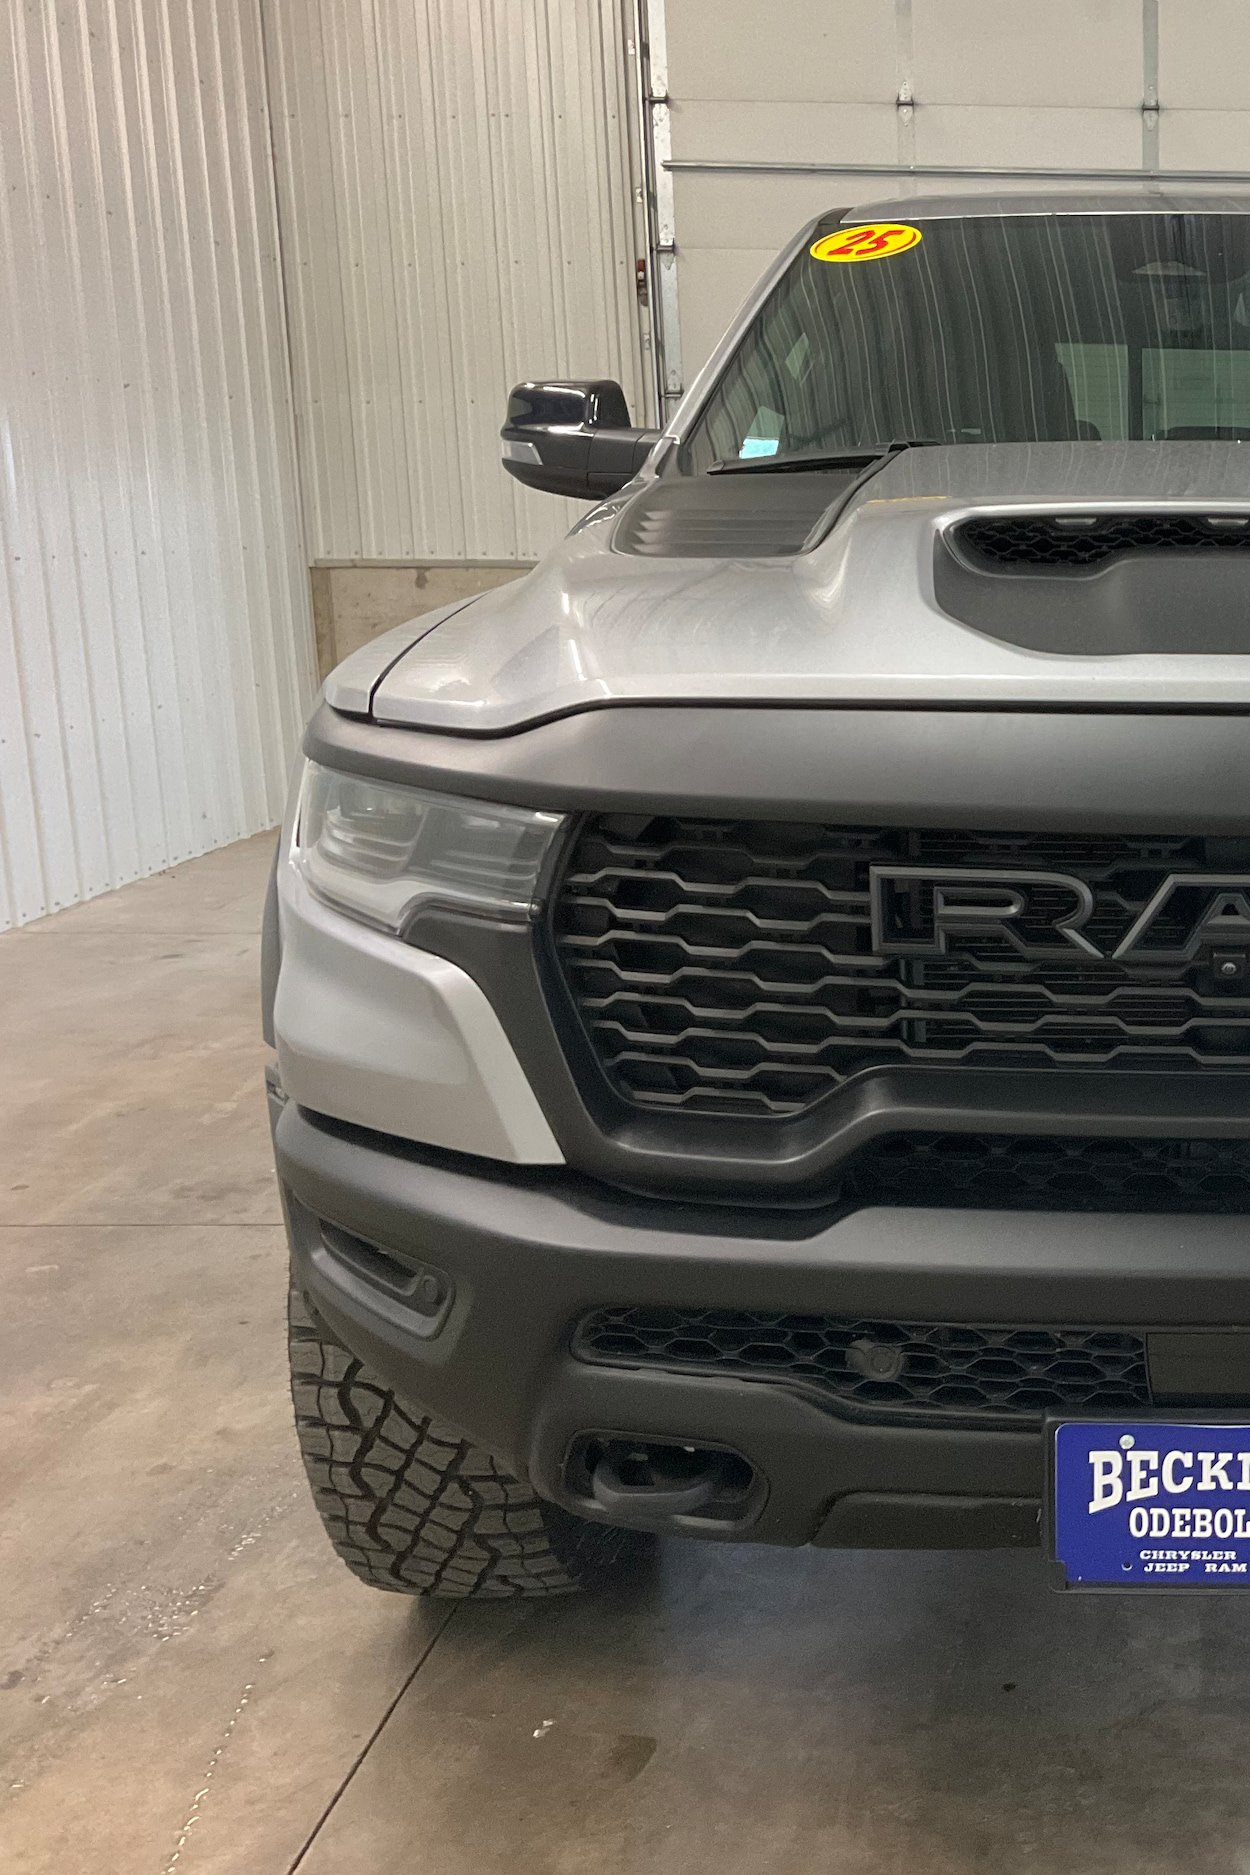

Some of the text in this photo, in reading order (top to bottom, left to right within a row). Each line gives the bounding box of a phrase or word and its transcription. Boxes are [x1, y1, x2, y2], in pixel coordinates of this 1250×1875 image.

[827, 230, 906, 255] 25
[1139, 1550, 1237, 1560] CHRYSLER
[1143, 1563, 1190, 1573] JEEP
[1204, 1563, 1247, 1573] RAM
